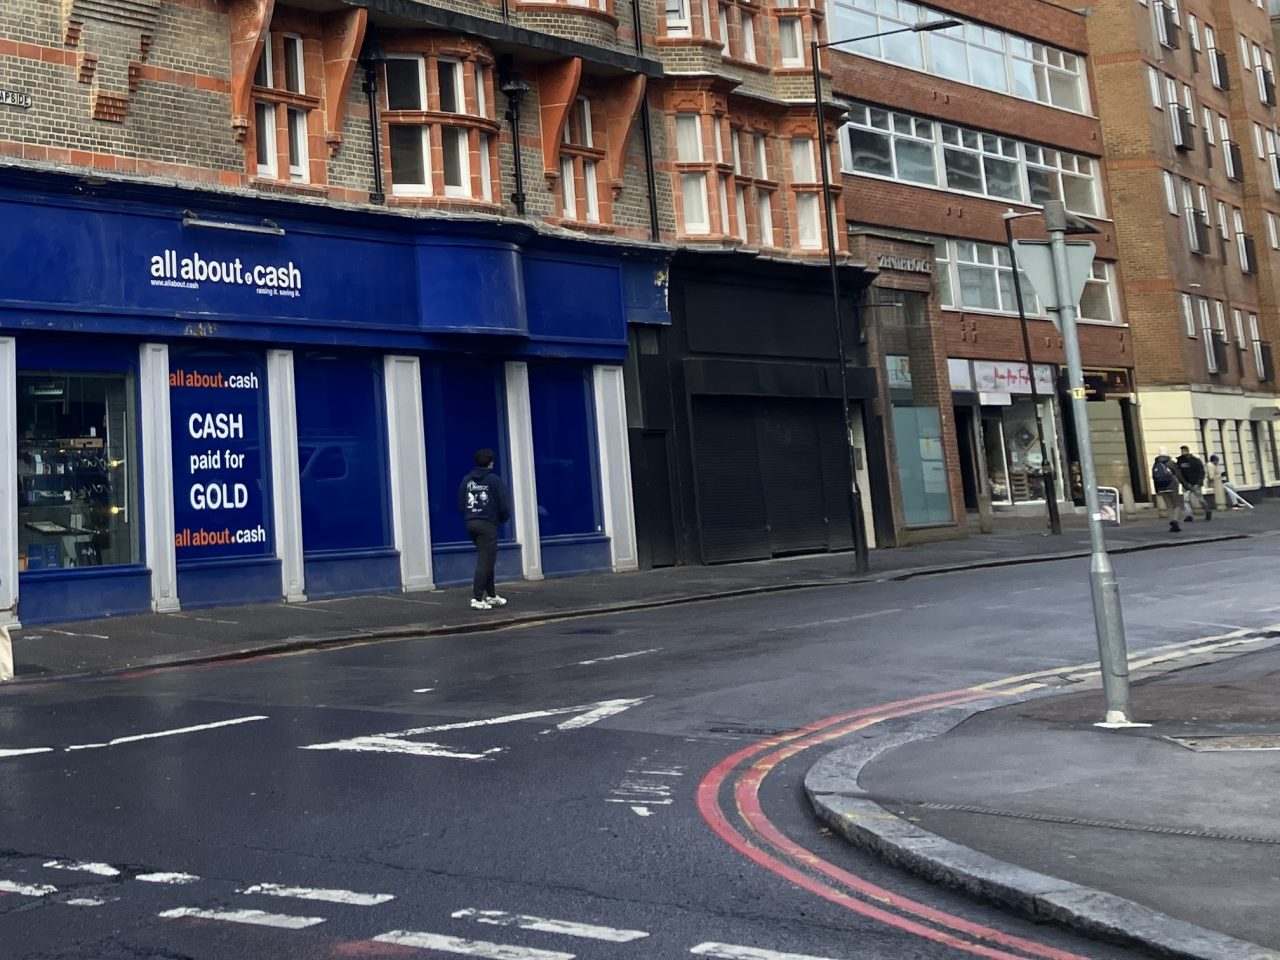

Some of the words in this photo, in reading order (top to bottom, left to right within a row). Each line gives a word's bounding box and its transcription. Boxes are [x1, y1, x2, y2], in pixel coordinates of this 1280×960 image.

[151, 249, 177, 278] all
[256, 288, 273, 296] raising
[170, 370, 184, 386] all
[189, 413, 243, 439] CASH
[190, 450, 221, 474] paid
[225, 449, 244, 469] for
[190, 483, 248, 510] GOLD
[176, 528, 191, 546] all
